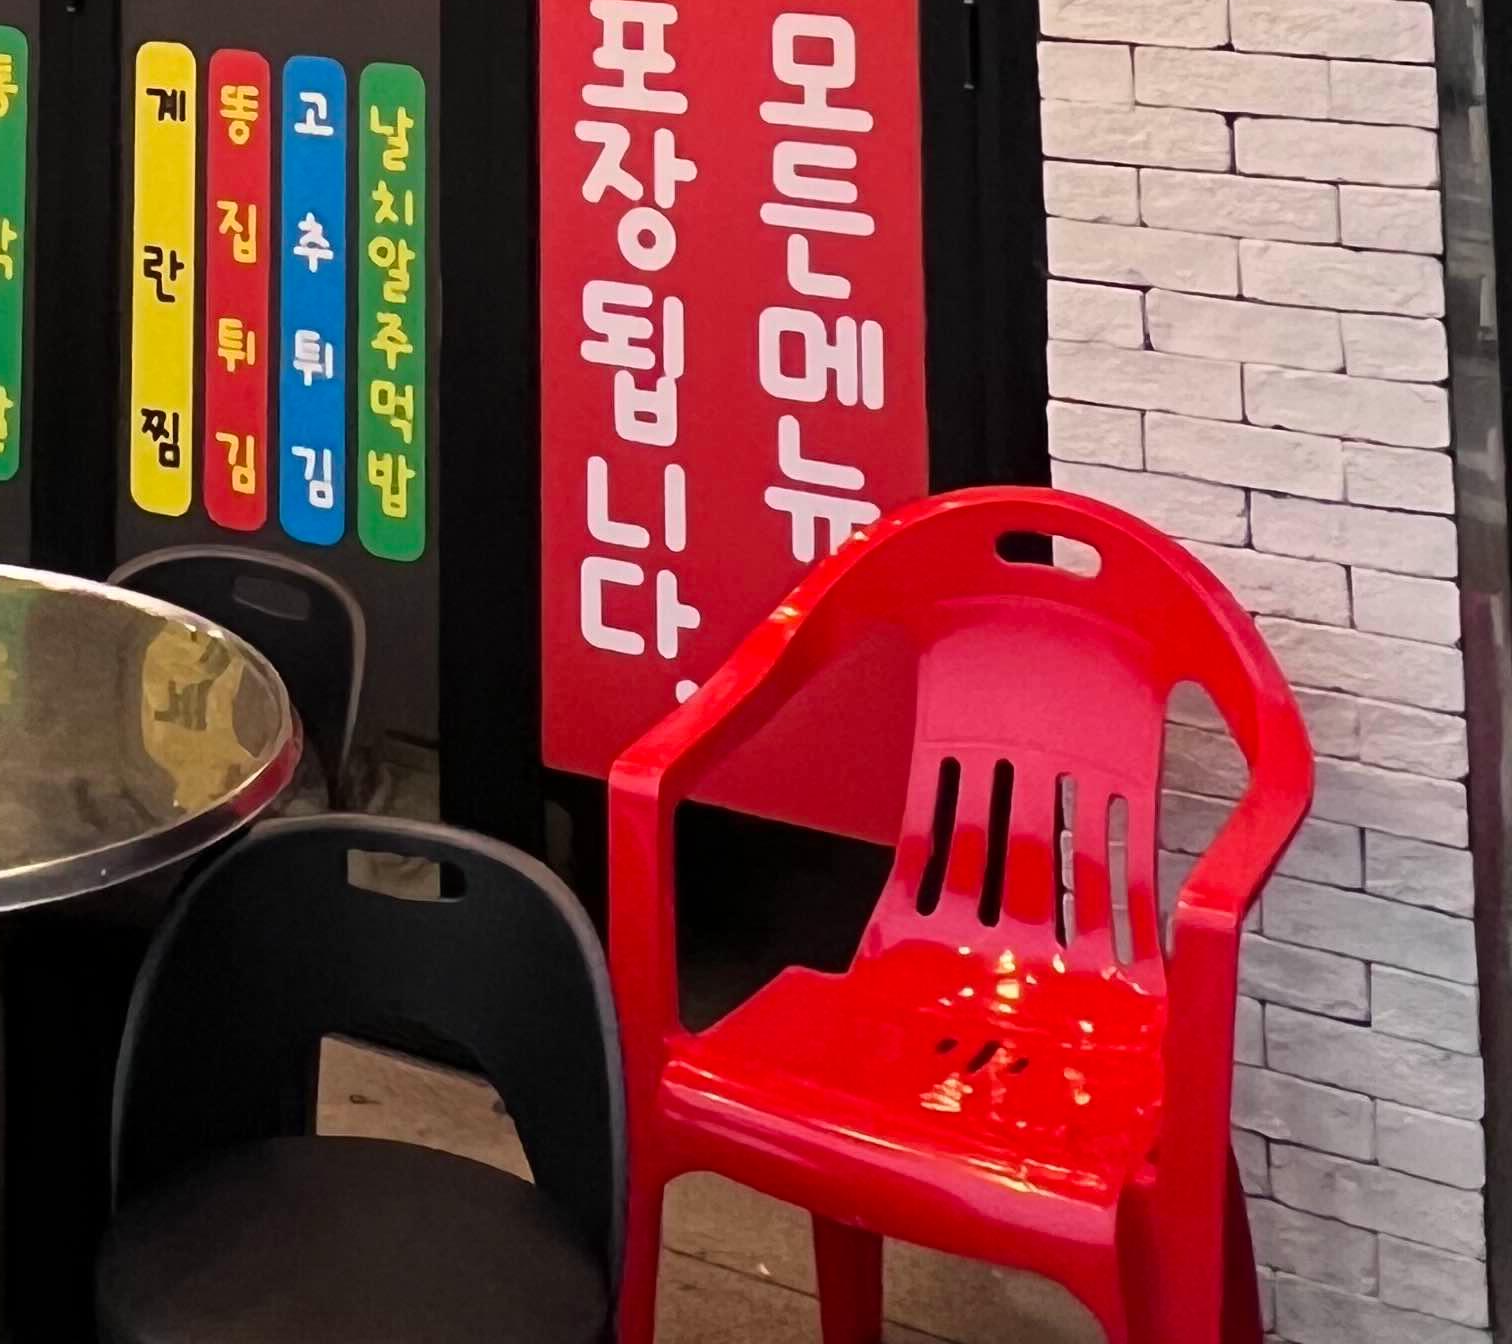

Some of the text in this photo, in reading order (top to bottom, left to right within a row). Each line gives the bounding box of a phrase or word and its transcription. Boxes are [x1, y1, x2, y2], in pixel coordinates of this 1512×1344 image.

[140, 87, 187, 469] 계란찜
[215, 84, 259, 496] 똥집튀김
[291, 91, 335, 510] 고추튀김
[367, 105, 416, 520] 날치알주먹밥
